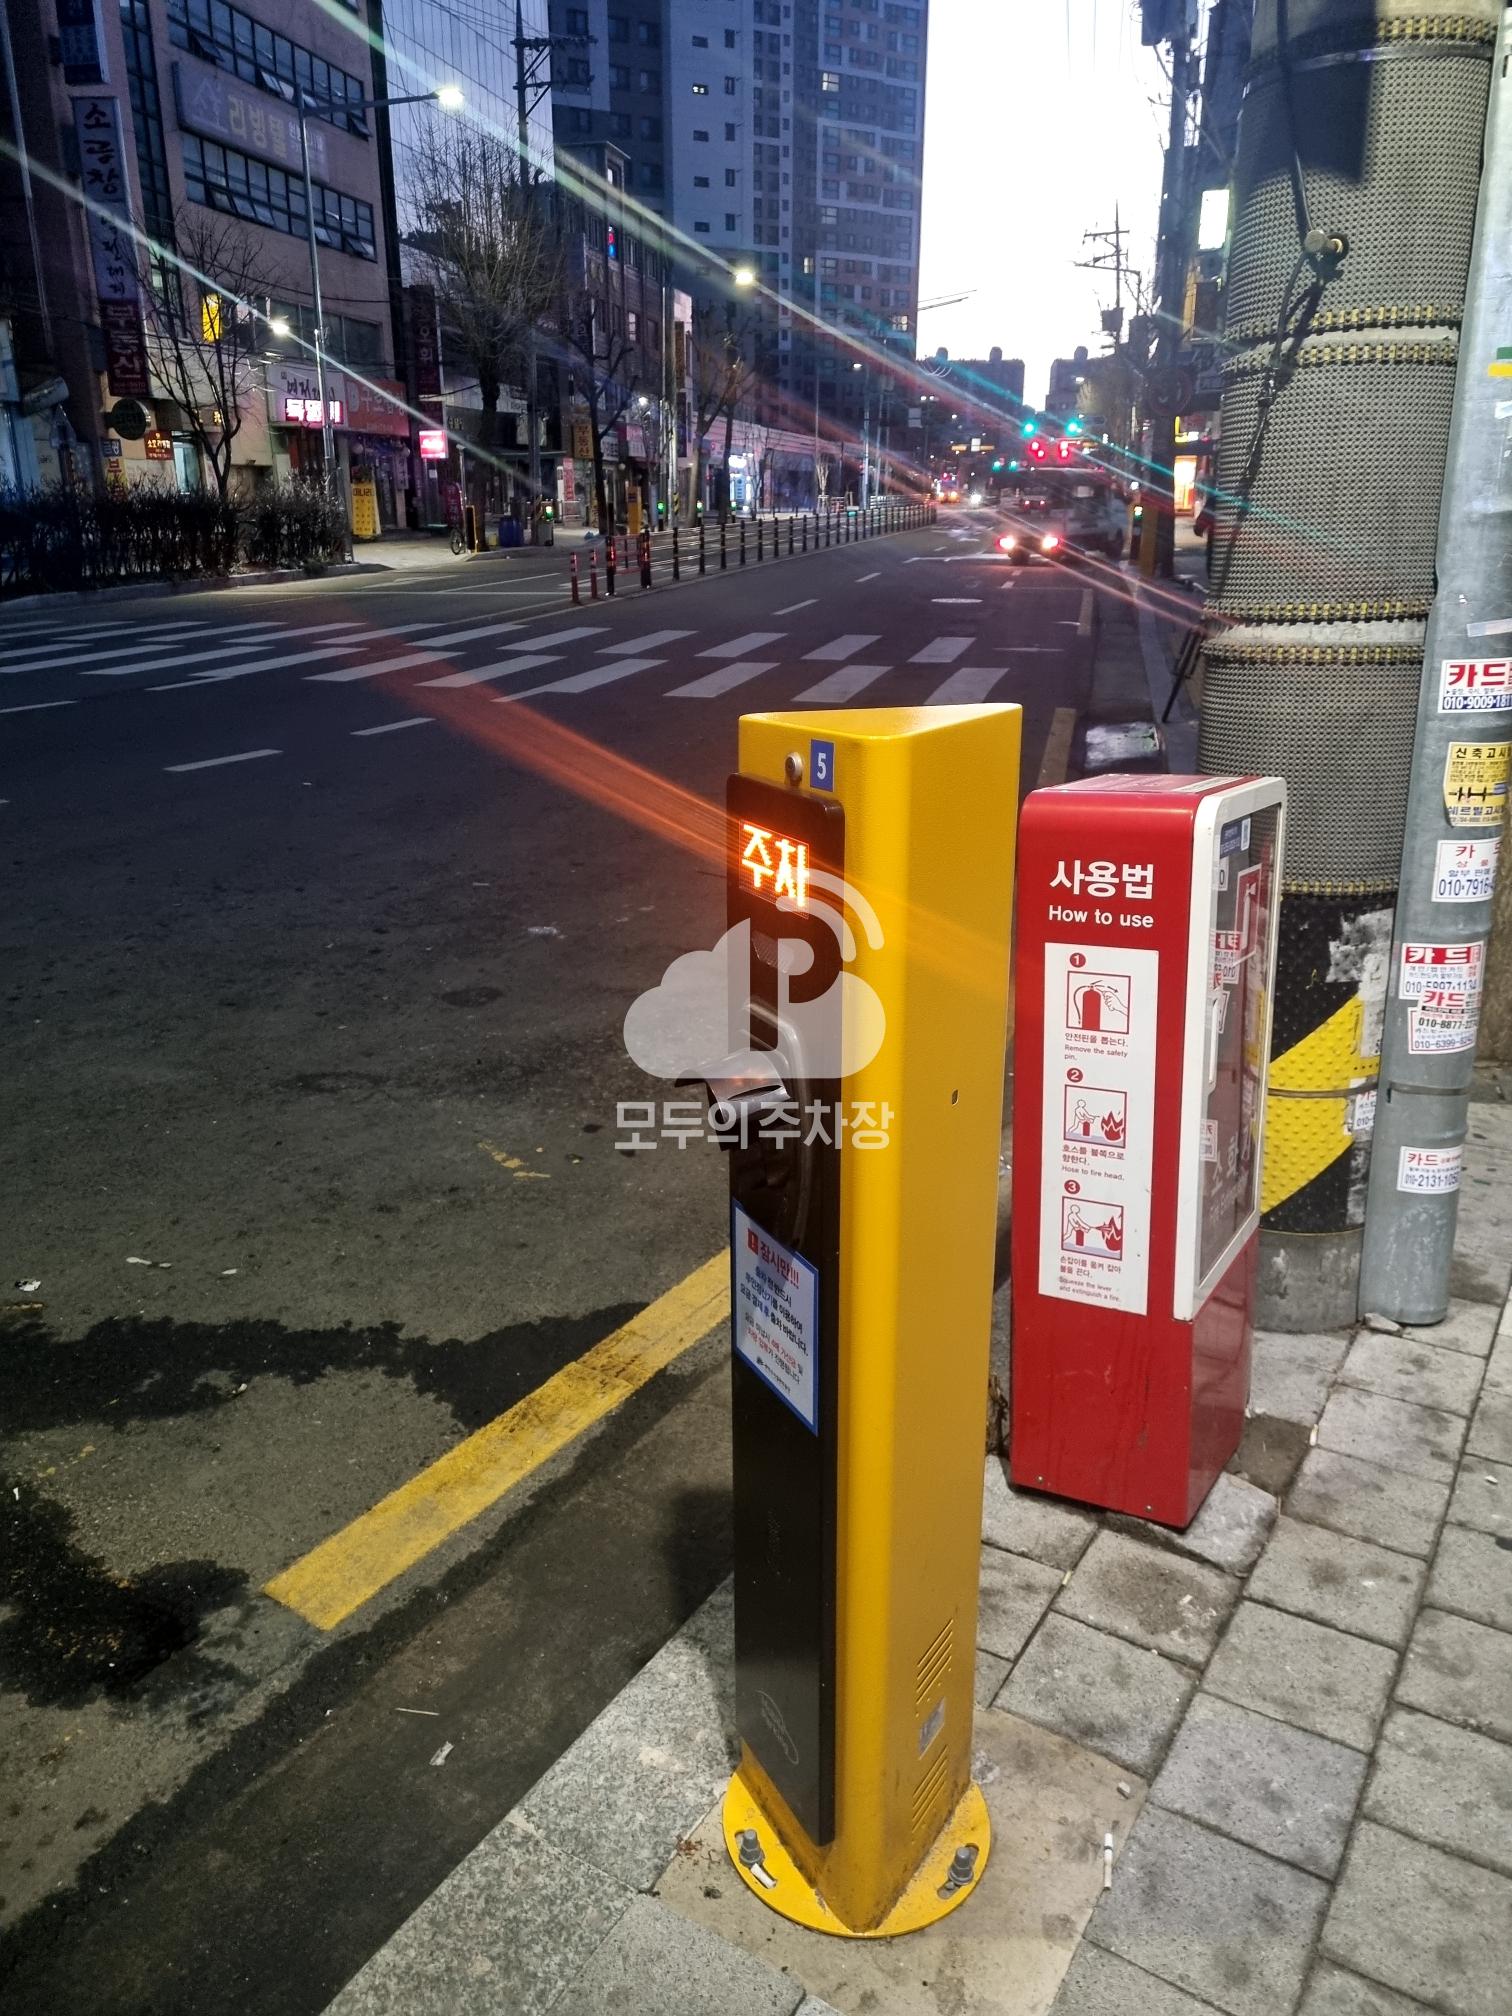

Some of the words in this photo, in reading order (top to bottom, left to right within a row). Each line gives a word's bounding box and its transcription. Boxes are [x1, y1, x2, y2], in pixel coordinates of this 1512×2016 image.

[1448, 663, 1506, 688] 카드
[815, 752, 828, 781] 5
[741, 824, 809, 909] 주차
[1049, 860, 1154, 900] 사용법
[1049, 905, 1088, 923] How
[1095, 908, 1113, 925] to
[1120, 913, 1154, 928] use
[1407, 947, 1469, 964] 카드
[1422, 990, 1466, 1007] 카드
[1064, 1032, 1098, 1044] 안전핀을
[1101, 1036, 1129, 1047] 뽑는다.
[1064, 1044, 1091, 1053] Remove
[1093, 1047, 1105, 1055] the
[1106, 1049, 1128, 1058] safety
[1062, 1144, 1087, 1155] 호스를
[1407, 1152, 1438, 1166] 카드
[1062, 1165, 1079, 1174] Hose
[1090, 1169, 1102, 1177] fire
[1059, 1285, 1071, 1293] and
[1086, 1279, 1095, 1288] the
[1097, 1282, 1112, 1292] lever
